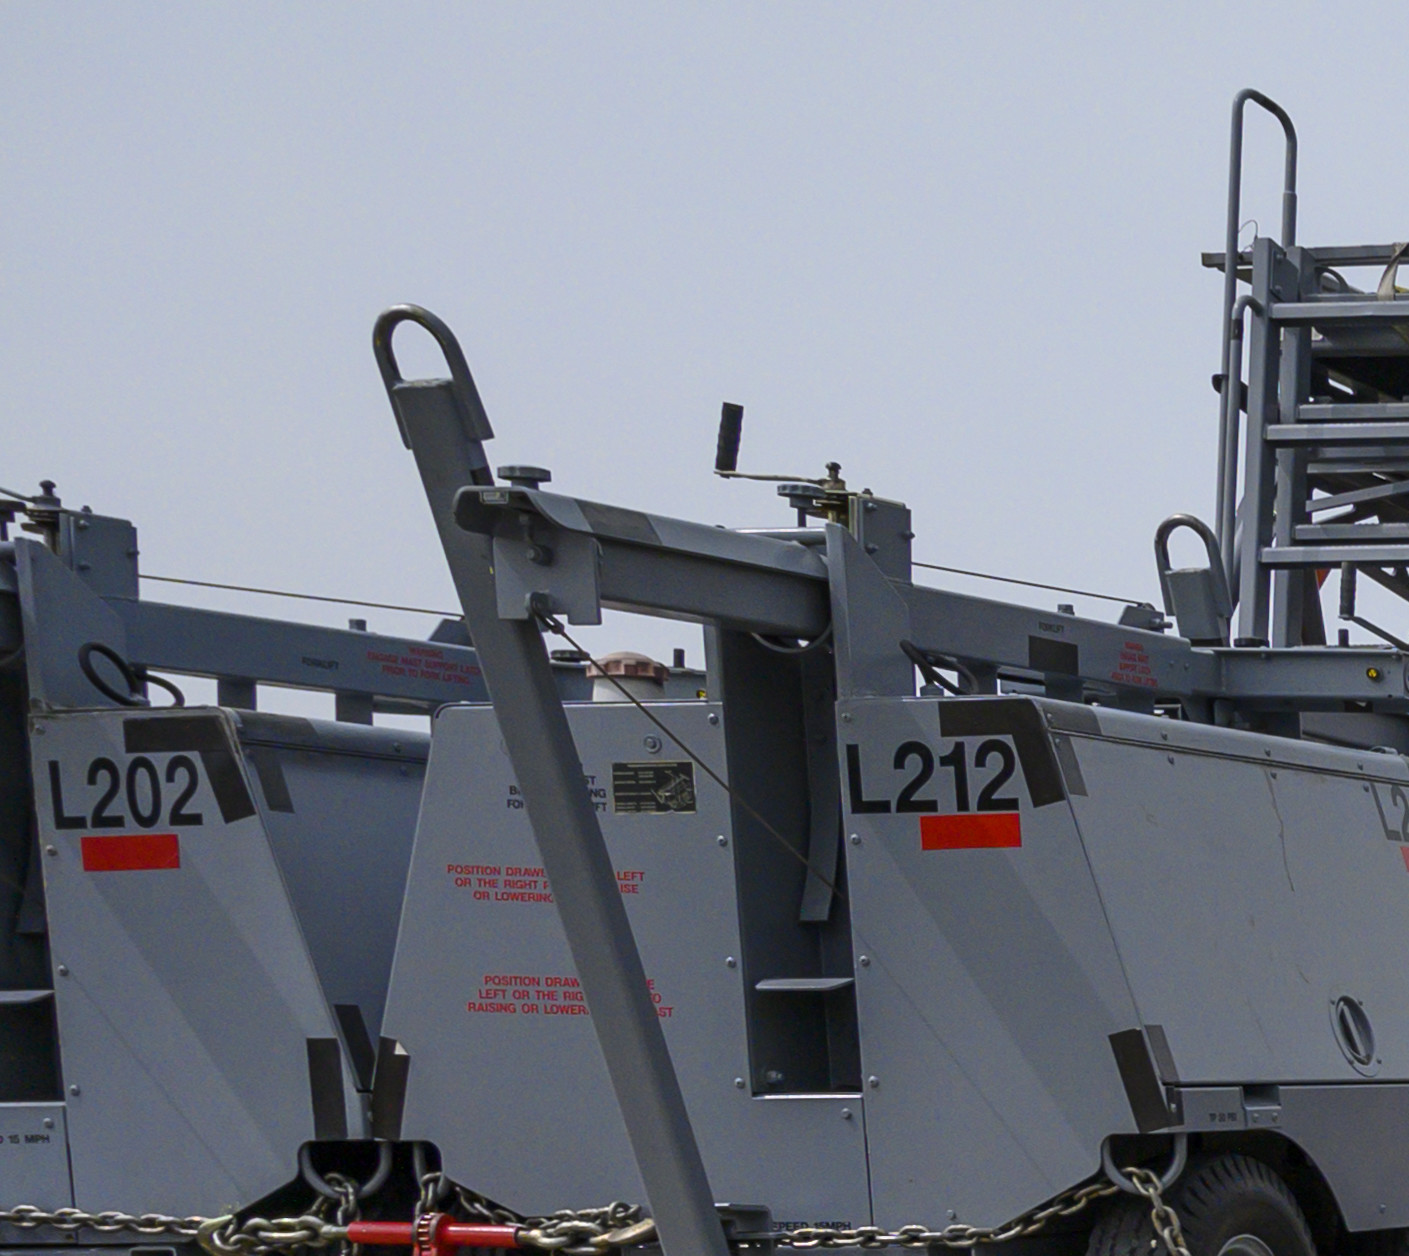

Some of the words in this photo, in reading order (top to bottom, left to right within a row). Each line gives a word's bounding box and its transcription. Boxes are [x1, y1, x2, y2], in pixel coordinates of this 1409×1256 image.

[846, 739, 1019, 814] L212
[48, 754, 204, 830] L202
[447, 864, 501, 876] POSITION
[616, 871, 645, 882] LEFT
[454, 877, 472, 888] OR
[477, 877, 498, 889] THE
[503, 878, 539, 890] RIGHT
[473, 890, 490, 901] OR
[484, 975, 540, 987] POSITION
[545, 976, 580, 987] DRAW
[478, 988, 507, 1000] LEFT
[512, 989, 530, 1000] OR
[535, 990, 558, 1001] THE
[563, 991, 584, 1001] RIG
[467, 1002, 516, 1014] RAISING
[521, 1003, 539, 1014] OR
[544, 1003, 588, 1015] LOWER
